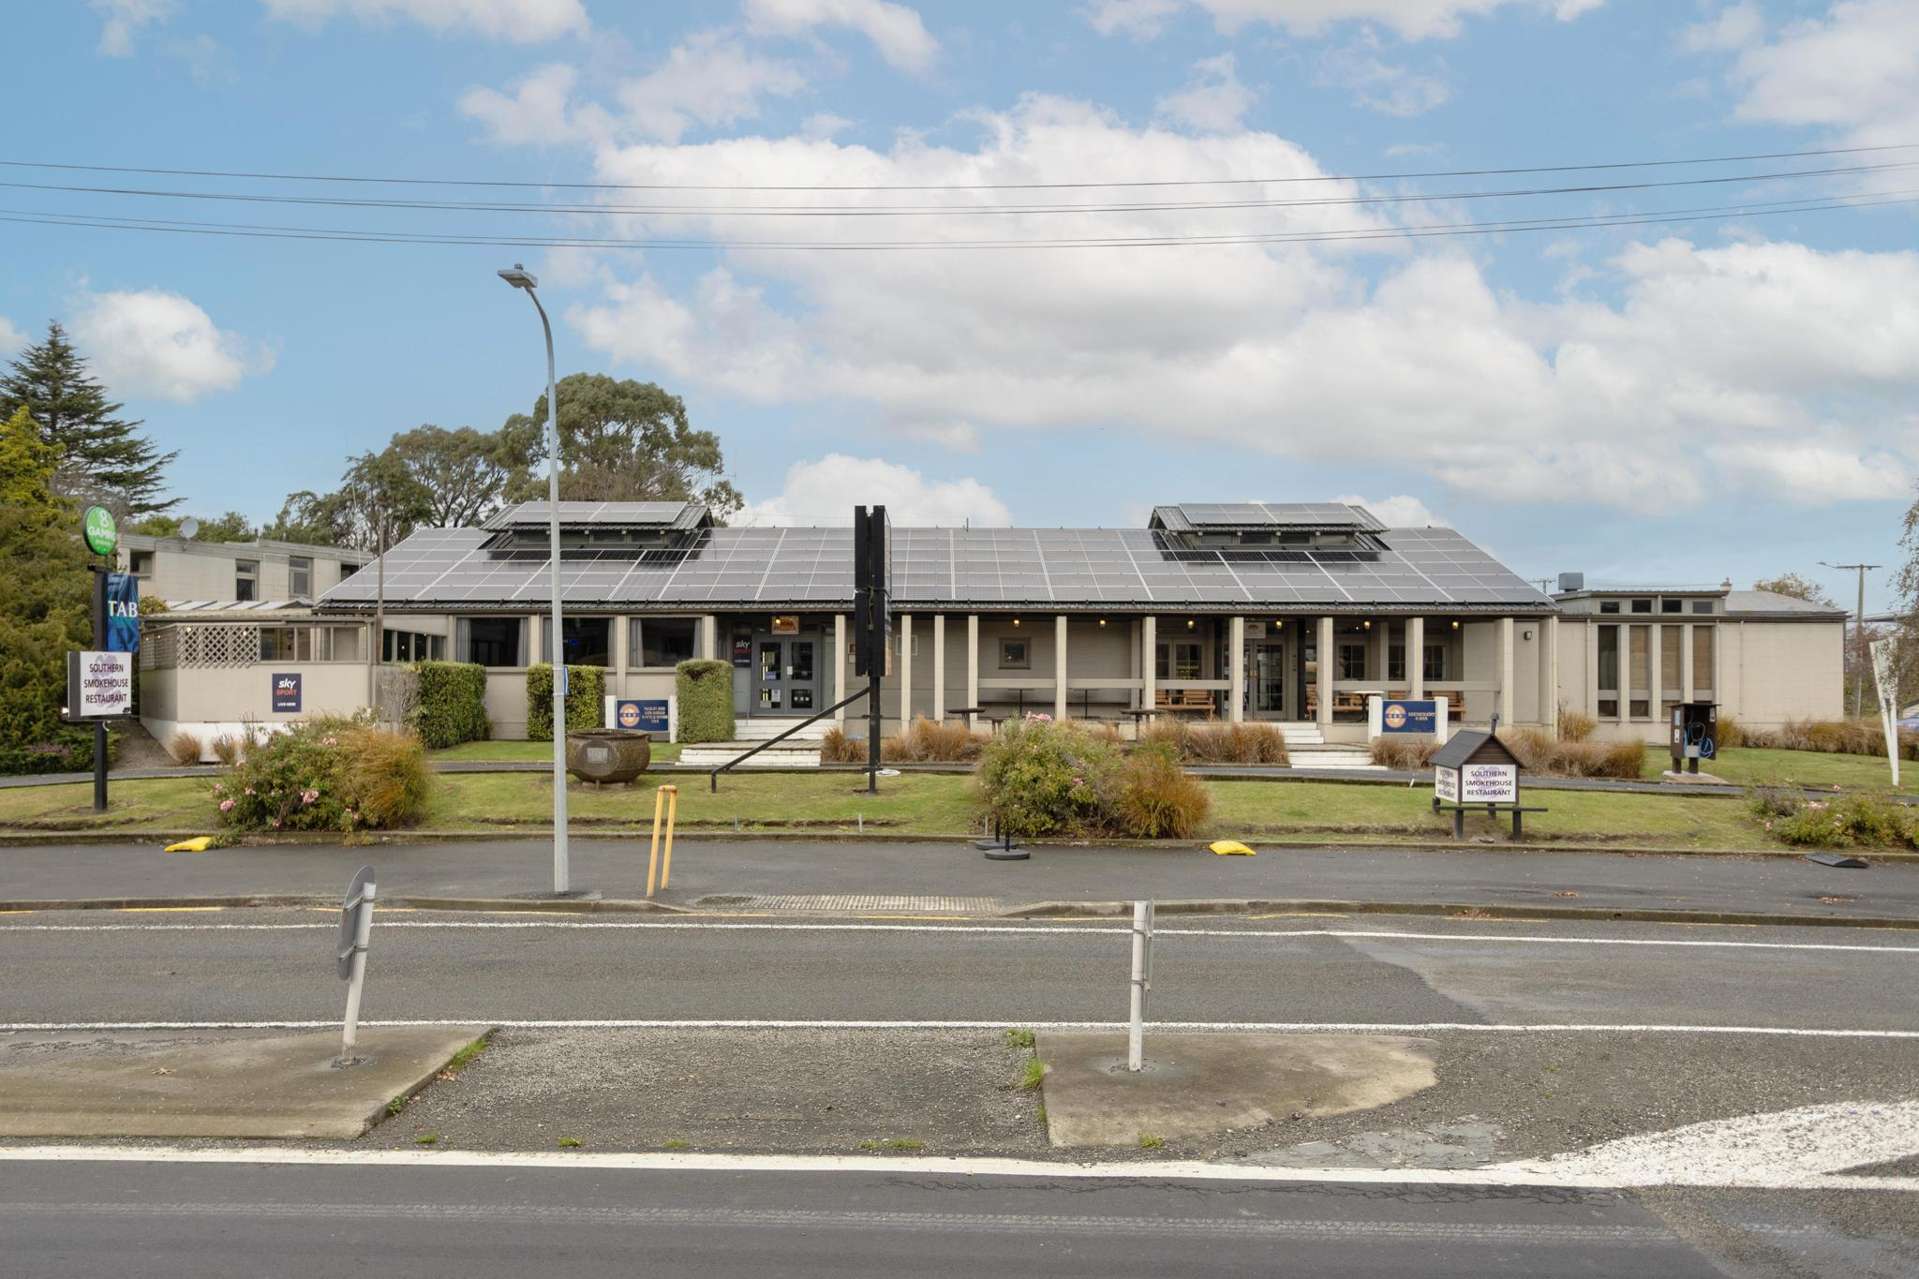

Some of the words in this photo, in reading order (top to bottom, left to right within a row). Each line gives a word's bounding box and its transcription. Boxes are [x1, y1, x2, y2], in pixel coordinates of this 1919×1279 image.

[107, 600, 138, 617] TAB
[89, 663, 124, 673] SOUTHERN
[83, 678, 129, 689] SMOKEHOUSE
[85, 693, 128, 704] RESTAURANT
